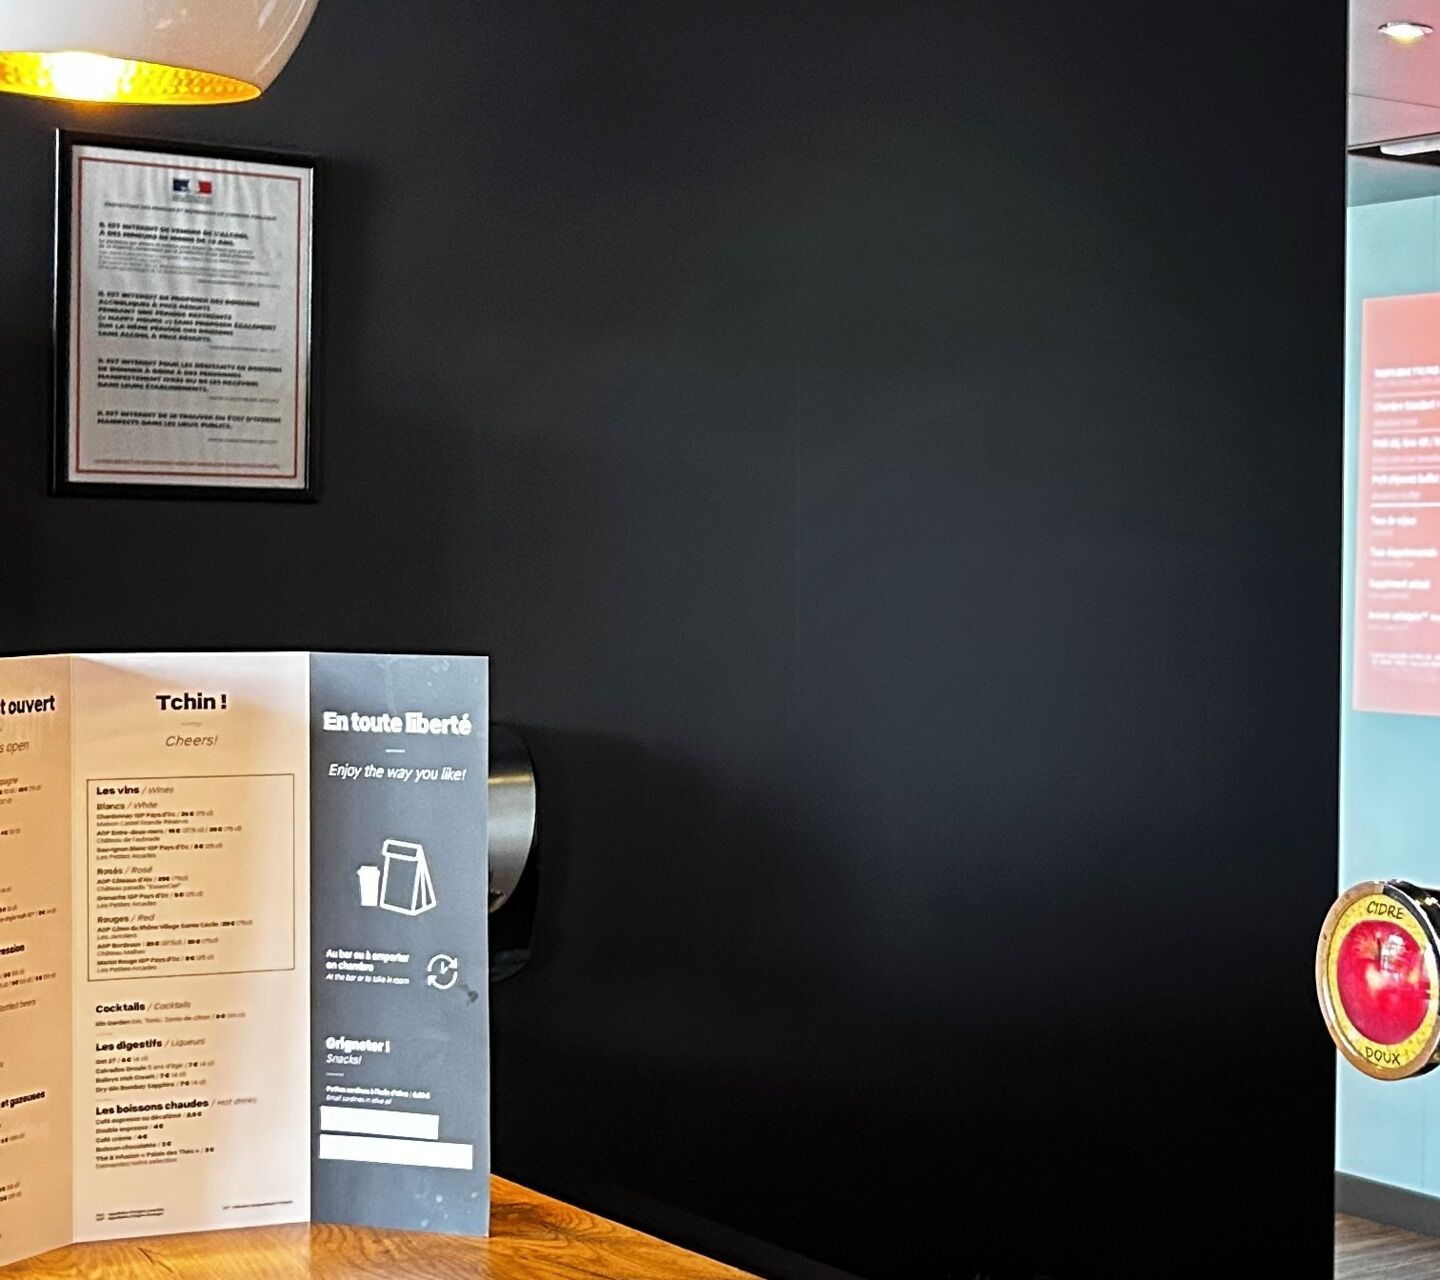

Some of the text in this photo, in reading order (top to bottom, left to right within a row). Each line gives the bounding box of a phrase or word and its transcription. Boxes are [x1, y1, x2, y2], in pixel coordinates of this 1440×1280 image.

[8, 695, 55, 715] ouvert
[156, 692, 227, 711] Tchin !
[323, 711, 472, 736] En toute liberté
[6, 740, 30, 754] open
[165, 735, 219, 747] Cheers!
[328, 763, 467, 783] Enjoy the way you like!
[96, 786, 115, 796] Les
[118, 785, 140, 795] vins
[1366, 900, 1405, 920] CIDRE
[95, 1001, 146, 1014] Cocktails
[95, 1042, 115, 1052] Les
[116, 1038, 163, 1052] digestifs
[1365, 1046, 1401, 1066] DOUX
[95, 1106, 115, 1116] Les
[116, 1103, 164, 1114] boissons
[165, 1099, 209, 1110] chaudes
